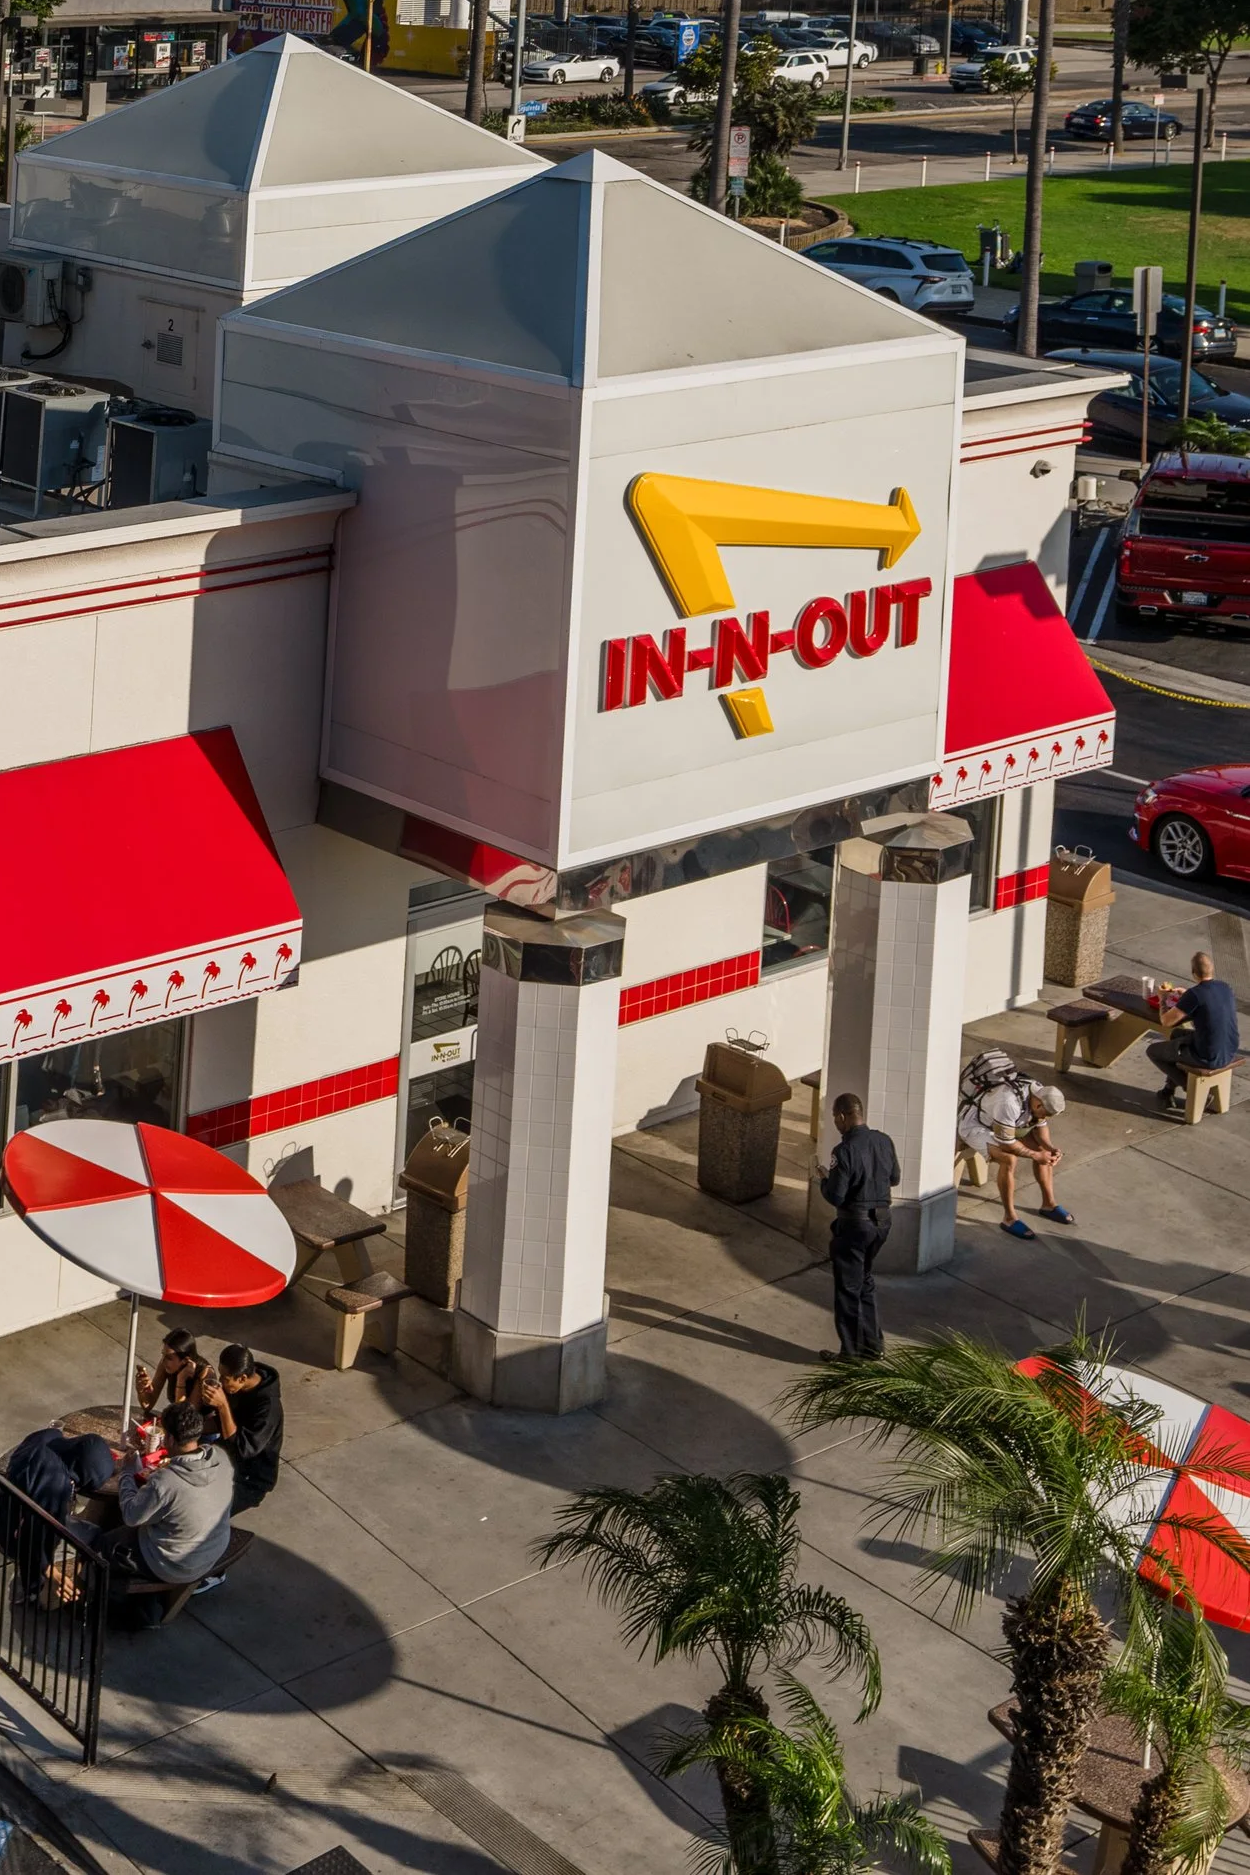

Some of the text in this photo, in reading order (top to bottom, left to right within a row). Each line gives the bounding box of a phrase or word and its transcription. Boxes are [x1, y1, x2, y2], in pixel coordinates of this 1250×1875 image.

[261, 6, 334, 35] WESTCHESTER
[168, 318, 174, 332] 2
[599, 577, 932, 713] IN-N-OUT
[431, 1047, 461, 1062] IN-N-OUT
